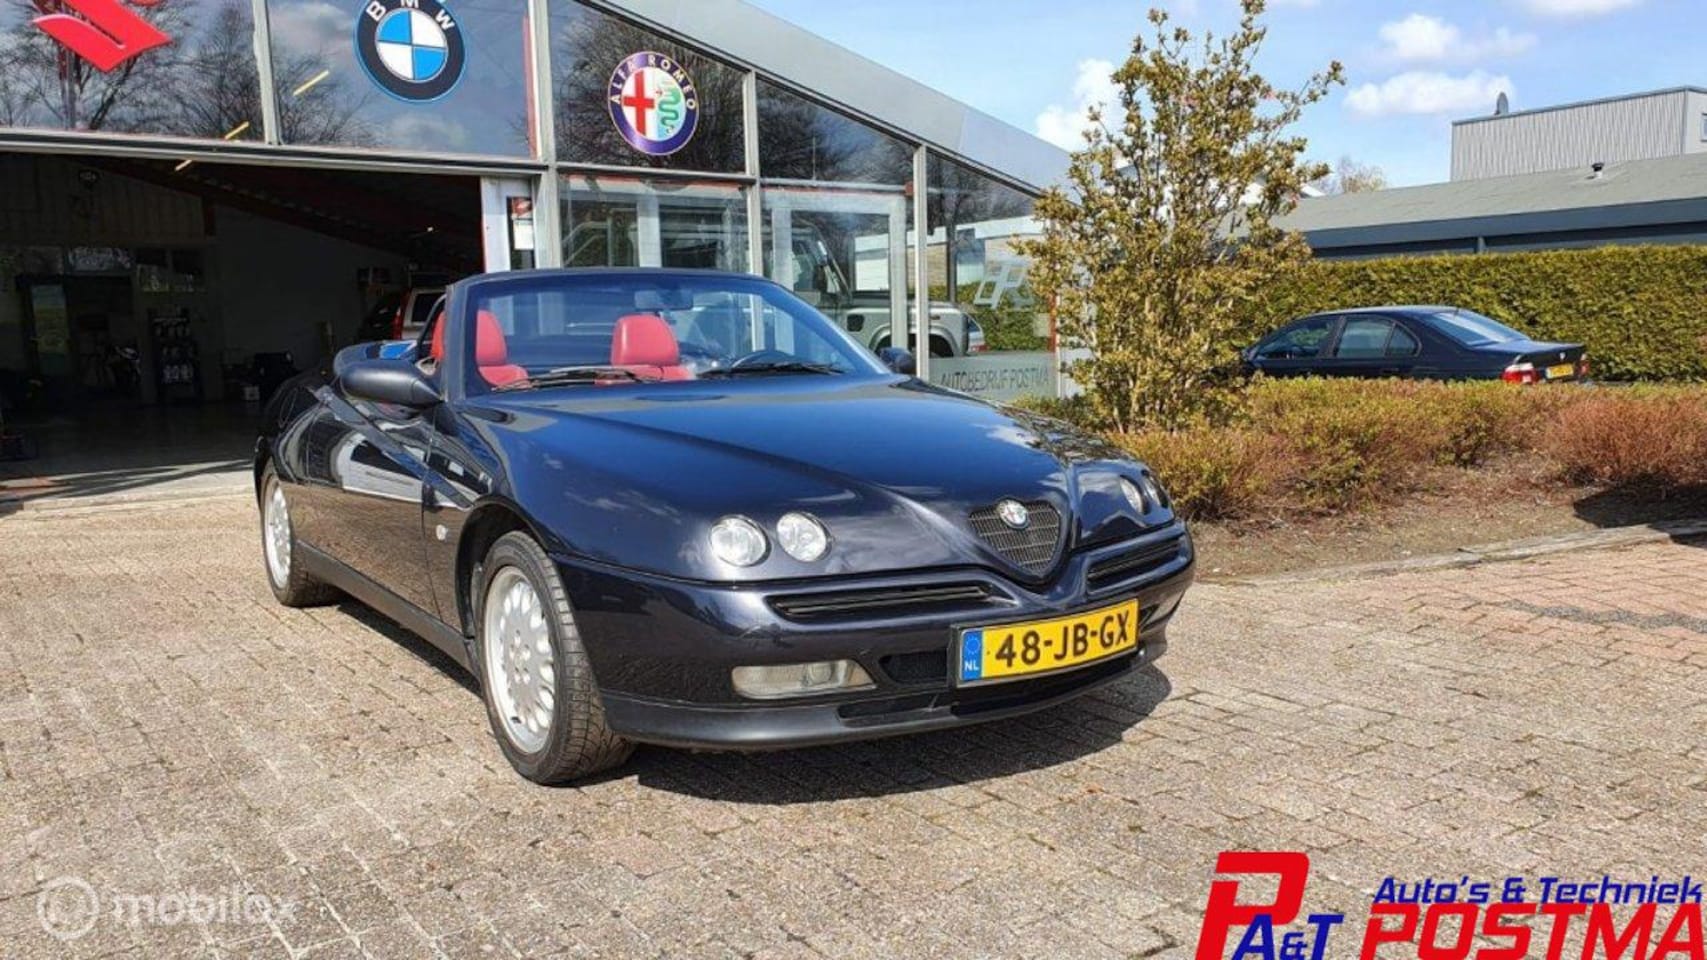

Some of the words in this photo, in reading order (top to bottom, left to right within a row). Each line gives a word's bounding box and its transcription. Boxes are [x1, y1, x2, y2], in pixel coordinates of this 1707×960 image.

[366, 0, 455, 30] BMW
[610, 59, 638, 104] ALFA
[647, 54, 696, 110] ROMEO
[995, 611, 1129, 668] 48-JB-GX
[964, 661, 979, 671] NL
